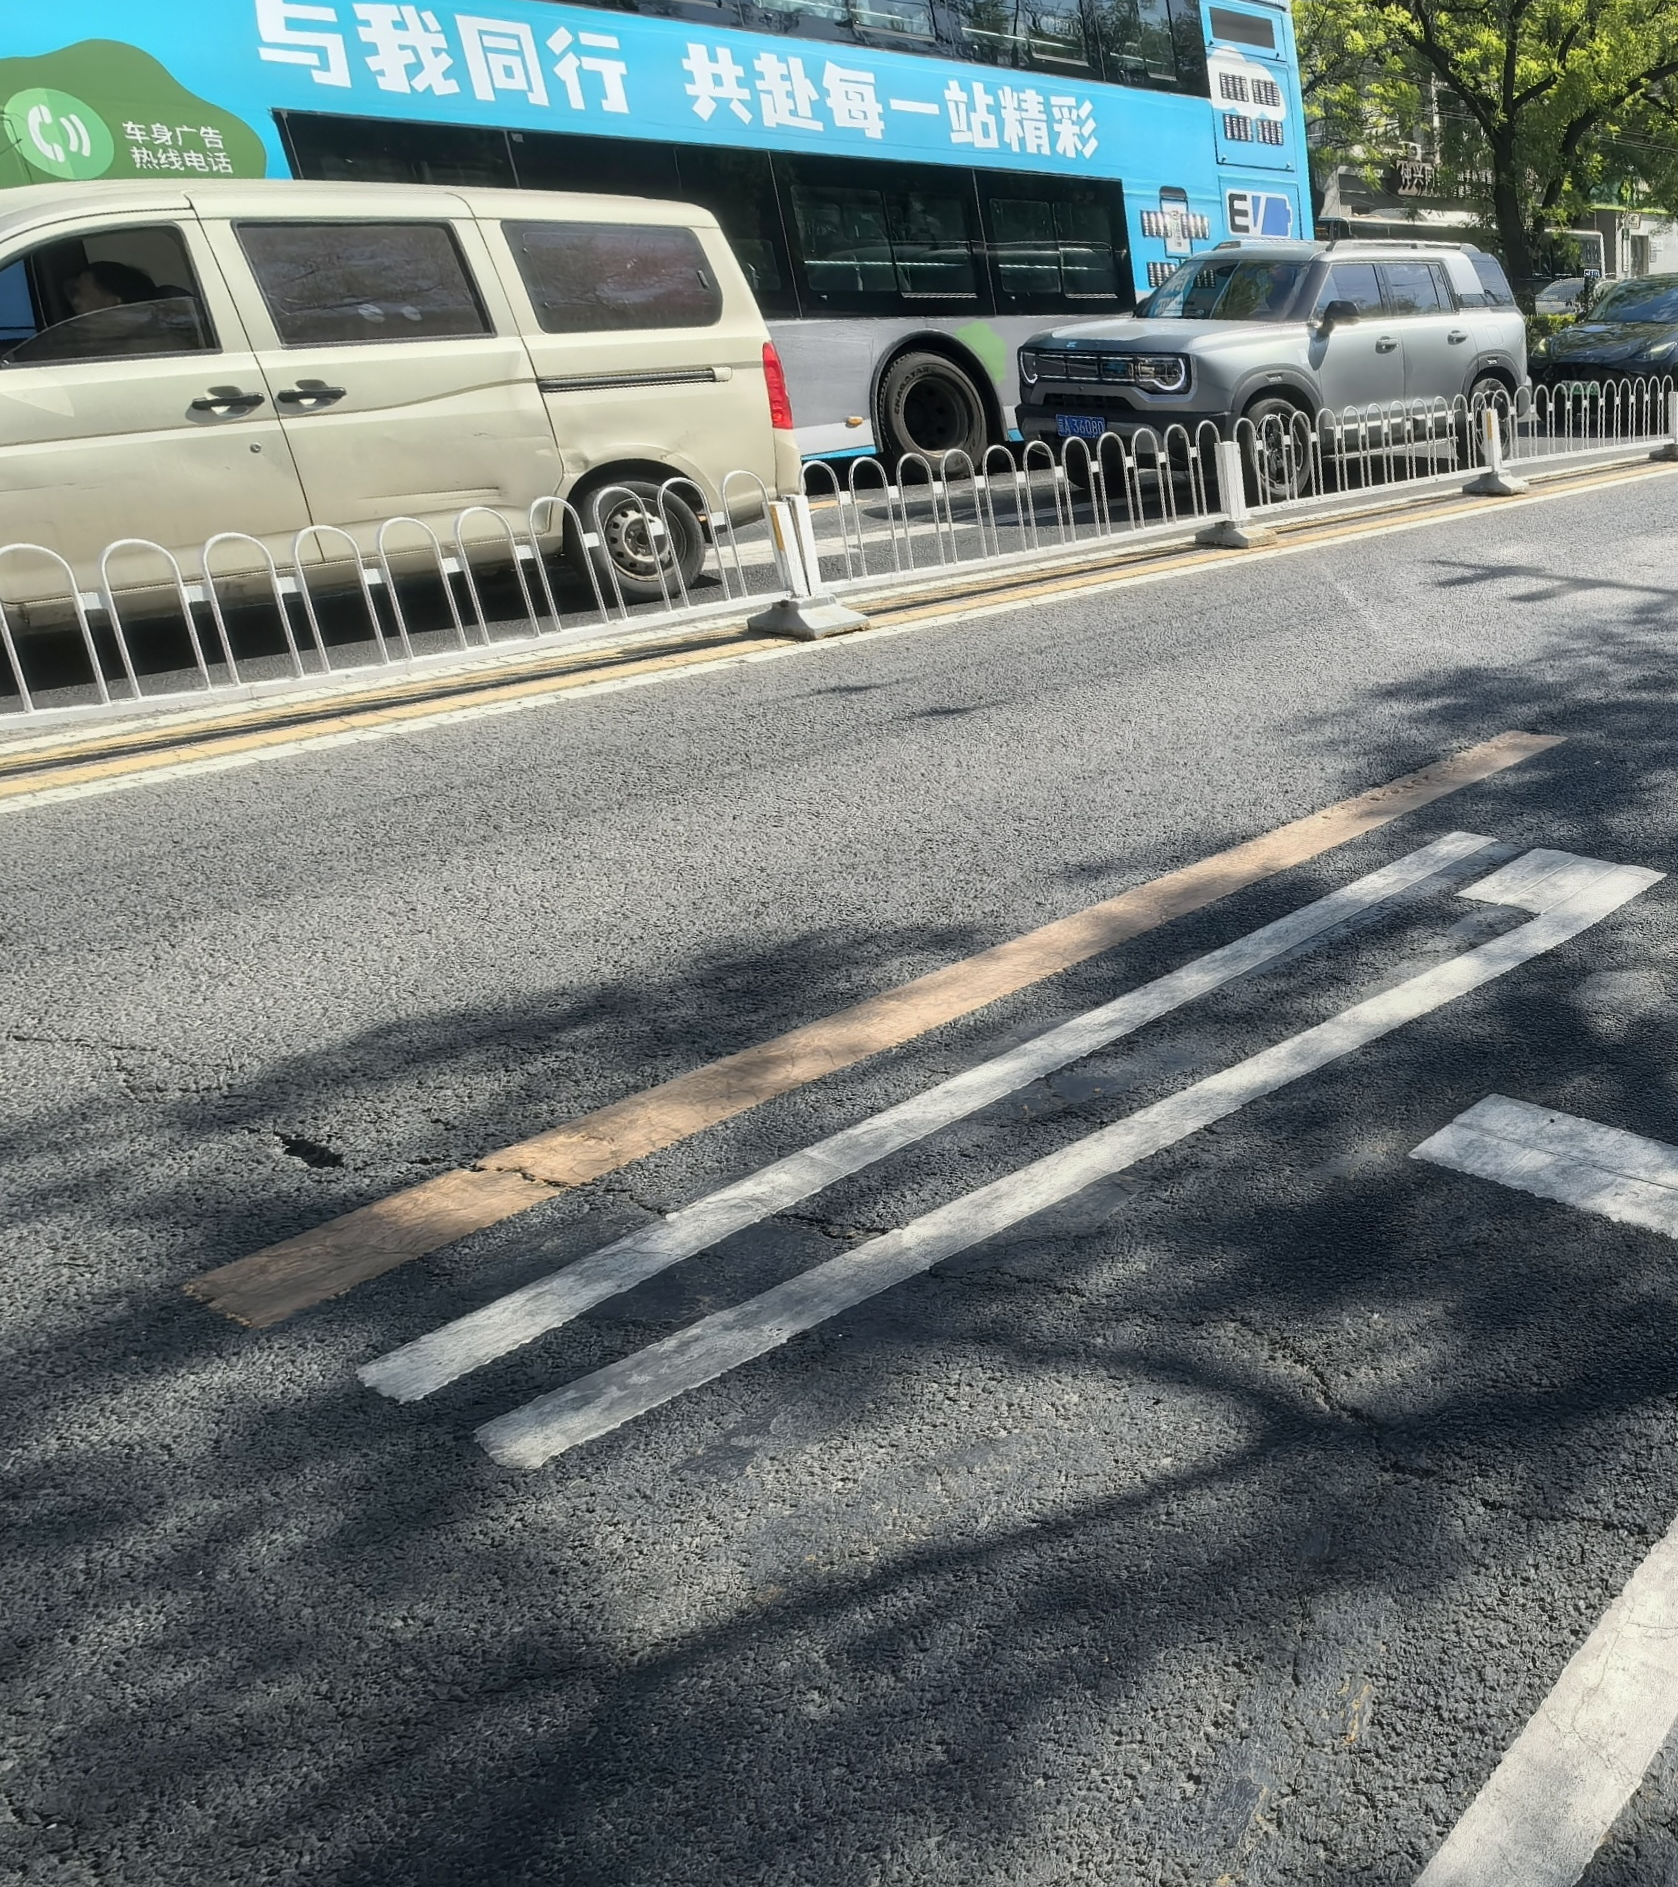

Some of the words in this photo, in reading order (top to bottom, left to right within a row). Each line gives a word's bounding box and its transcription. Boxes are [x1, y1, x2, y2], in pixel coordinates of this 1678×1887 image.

[255, 0, 630, 114] 与我同行
[683, 42, 1098, 160] 共赴每一站精彩
[121, 120, 224, 150] 车身广告
[129, 146, 234, 174] 热线电话
